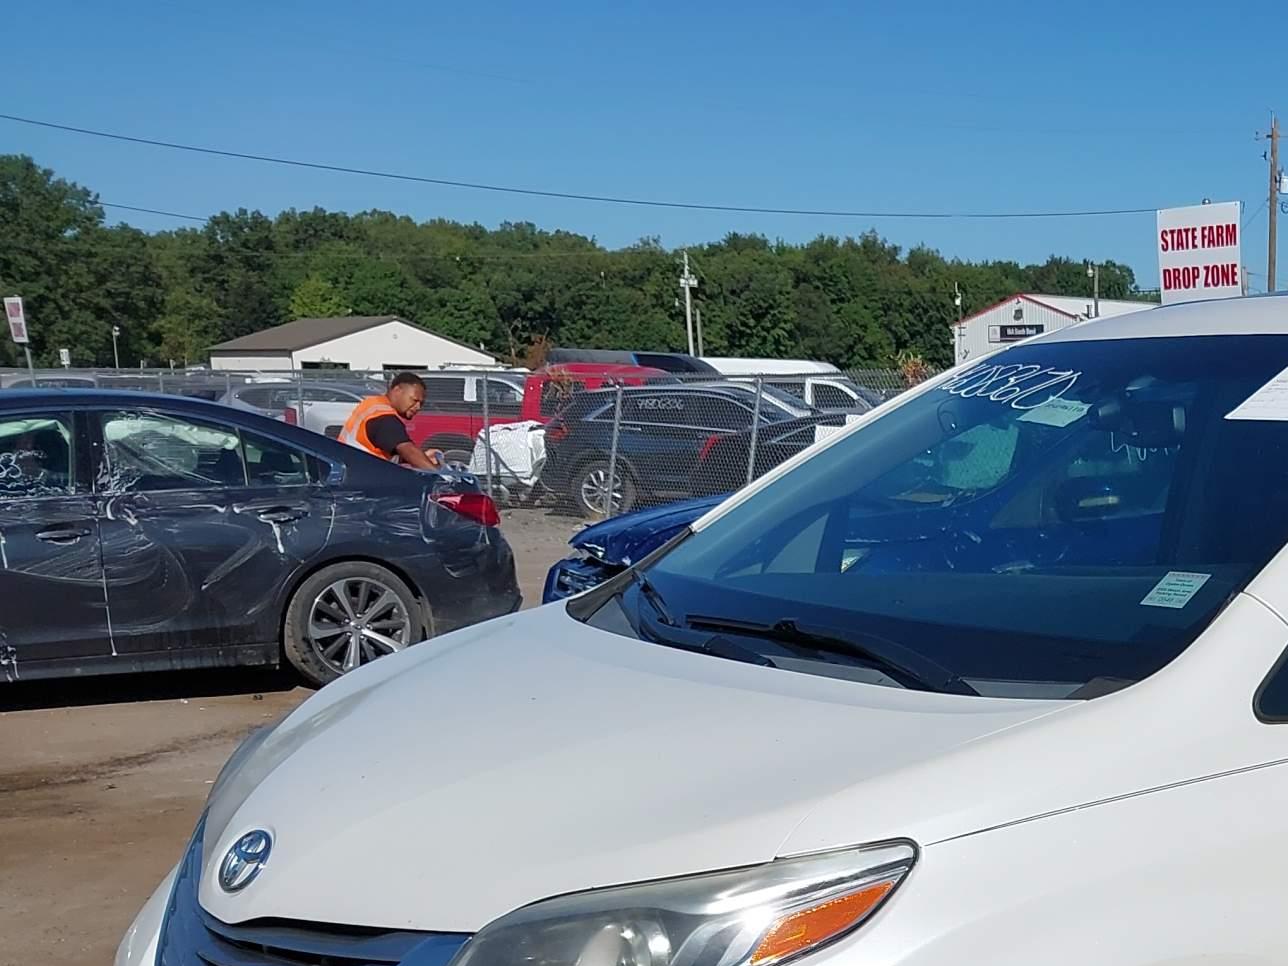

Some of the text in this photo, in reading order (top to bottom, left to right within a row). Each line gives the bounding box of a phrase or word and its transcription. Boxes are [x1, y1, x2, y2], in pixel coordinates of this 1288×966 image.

[1160, 223, 1237, 252] STATE FARM
[1162, 263, 1238, 290] DROP ZONE
